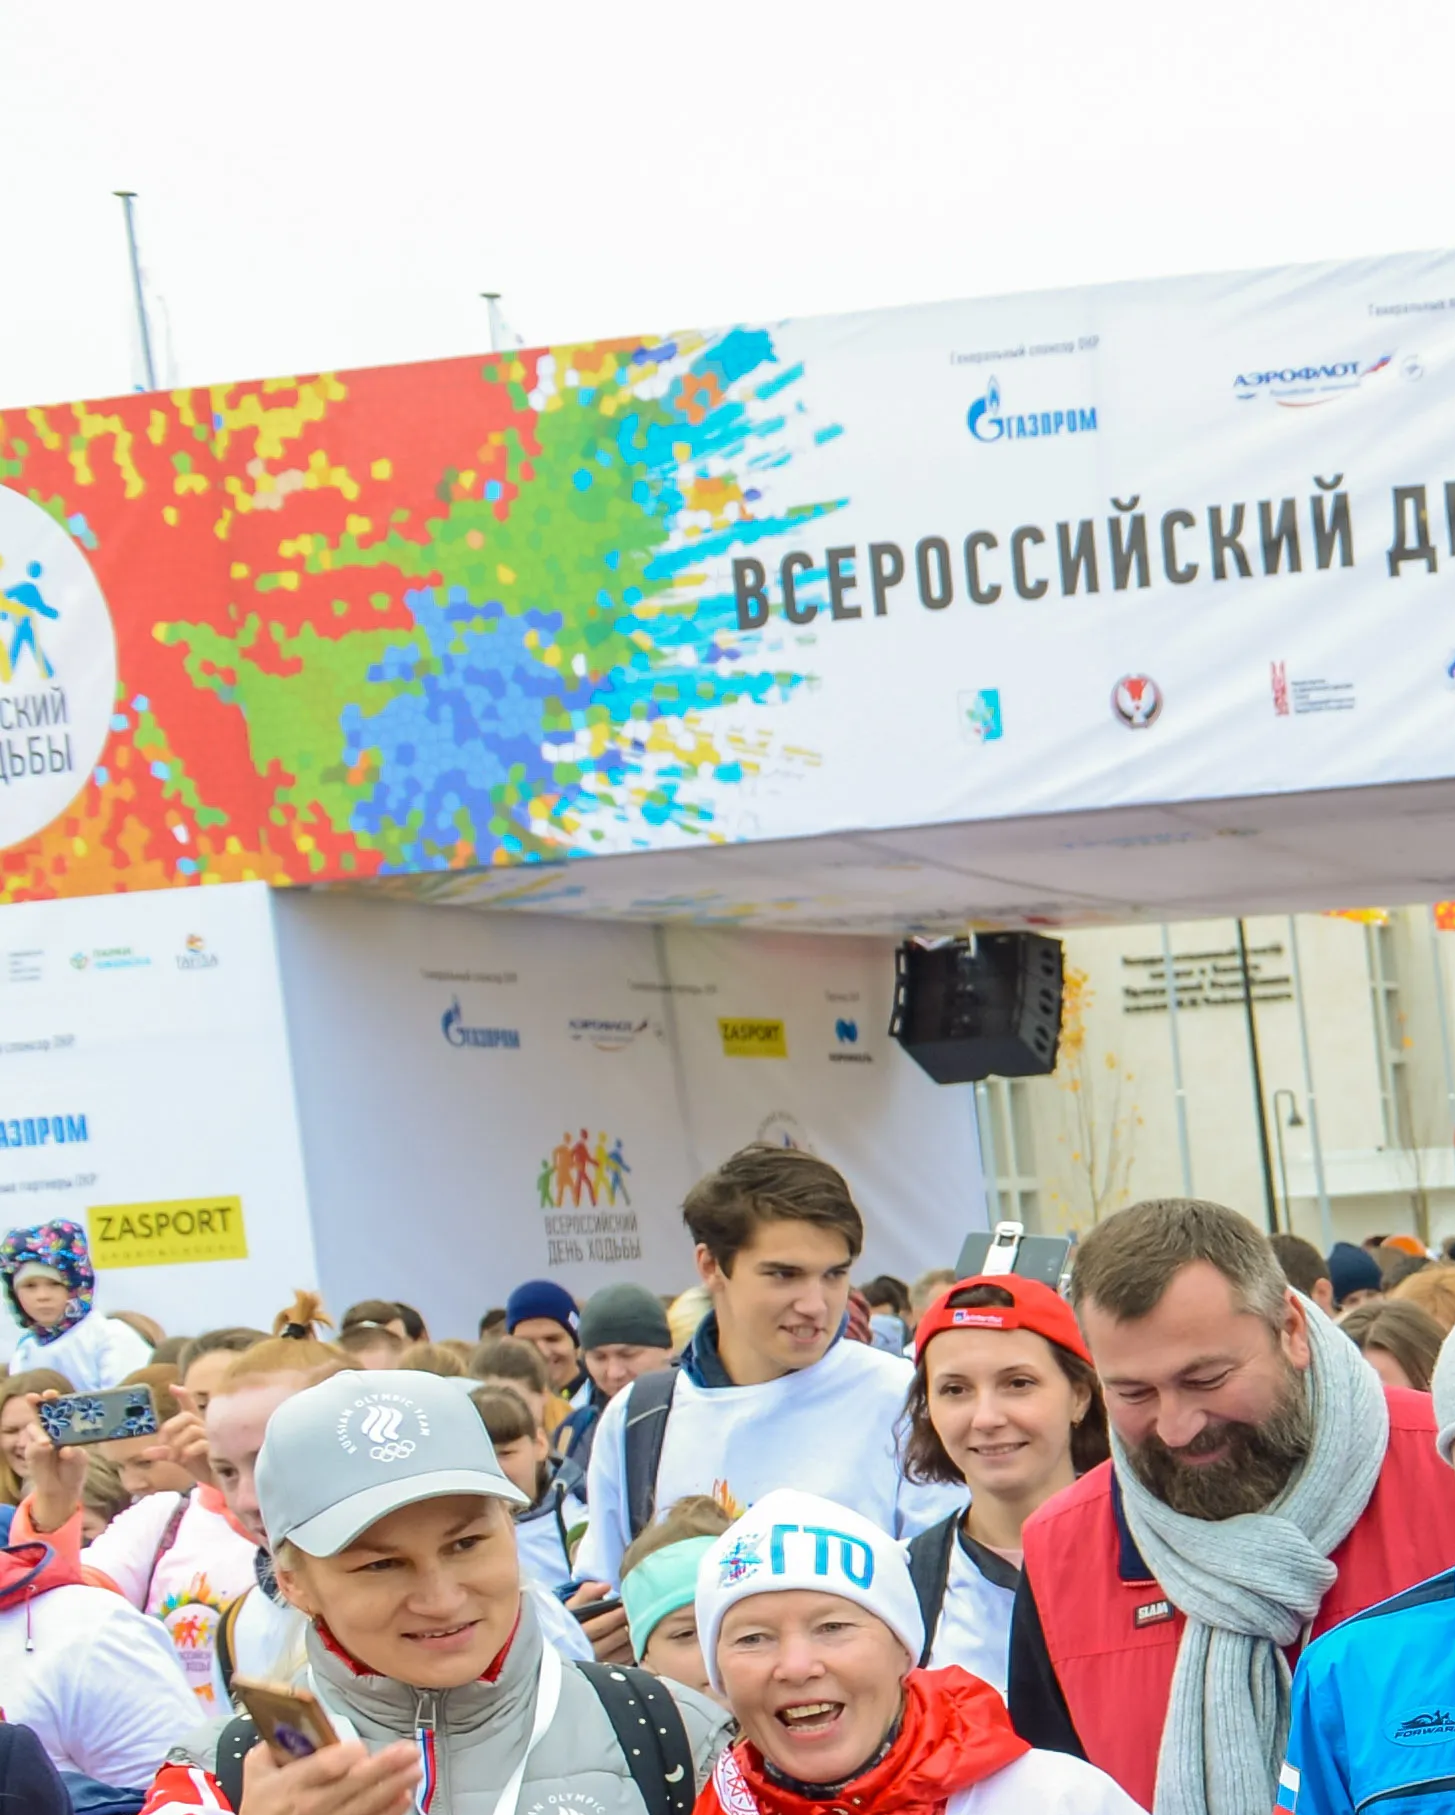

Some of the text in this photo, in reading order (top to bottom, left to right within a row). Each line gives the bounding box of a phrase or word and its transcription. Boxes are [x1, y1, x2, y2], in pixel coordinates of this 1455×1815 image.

[1233, 361, 1359, 387] АЭРОФЛОТ
[1007, 407, 1097, 440] ГАЗПРОМ
[732, 474, 1356, 632] ВСЕРОССИЙСКИЙ
[721, 1023, 781, 1043] ZASPORT
[96, 1207, 232, 1242] ZASPORT
[545, 1210, 638, 1235] ВСЕРОССИЙСКИЙ
[548, 1237, 641, 1266] ДЕНЬ ХОДЬБЫ
[337, 1393, 431, 1455] RUSSIAN OLYMPIC TEAM
[770, 1523, 874, 1590] ГТО
[548, 1793, 605, 1814] OLYMPIC
